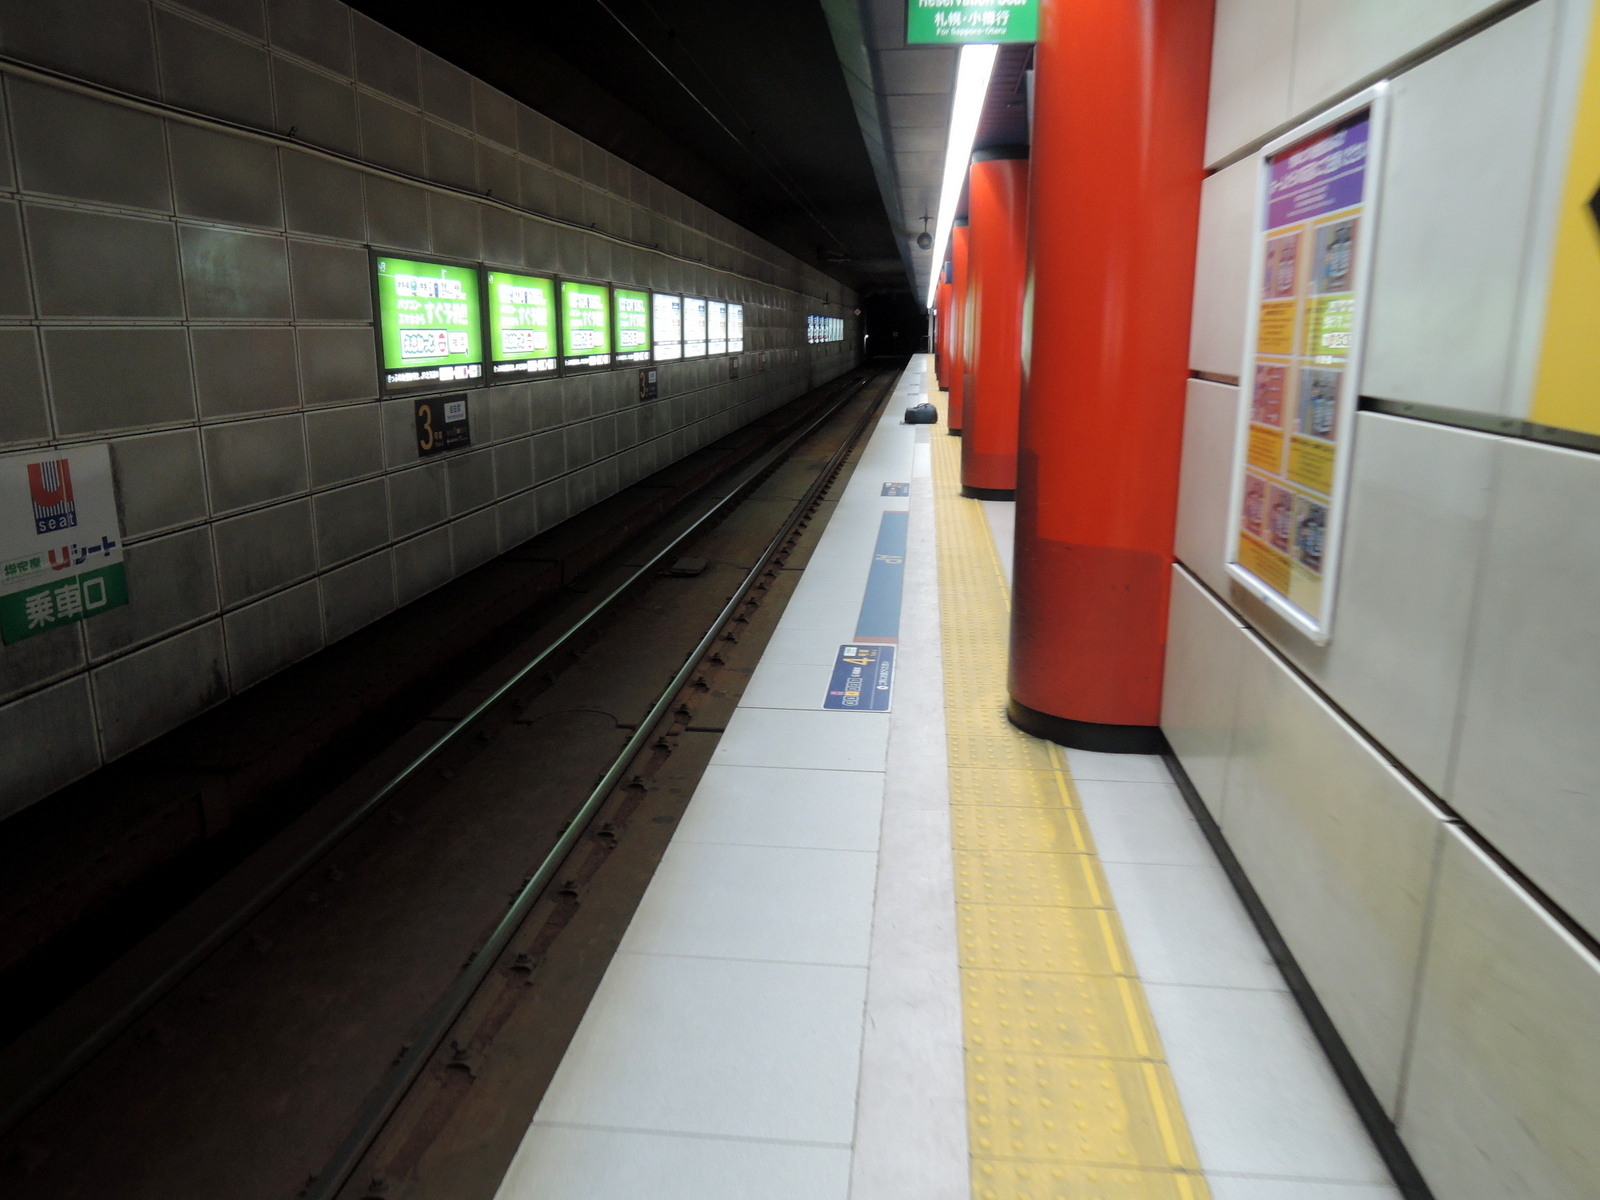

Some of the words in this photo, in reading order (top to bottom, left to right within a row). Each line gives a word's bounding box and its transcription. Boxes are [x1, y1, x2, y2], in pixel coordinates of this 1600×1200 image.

[640, 371, 646, 398] 3
[418, 404, 434, 450] 3
[38, 512, 75, 533] seat
[26, 576, 108, 630] 乗車口
[842, 657, 876, 666] 4
